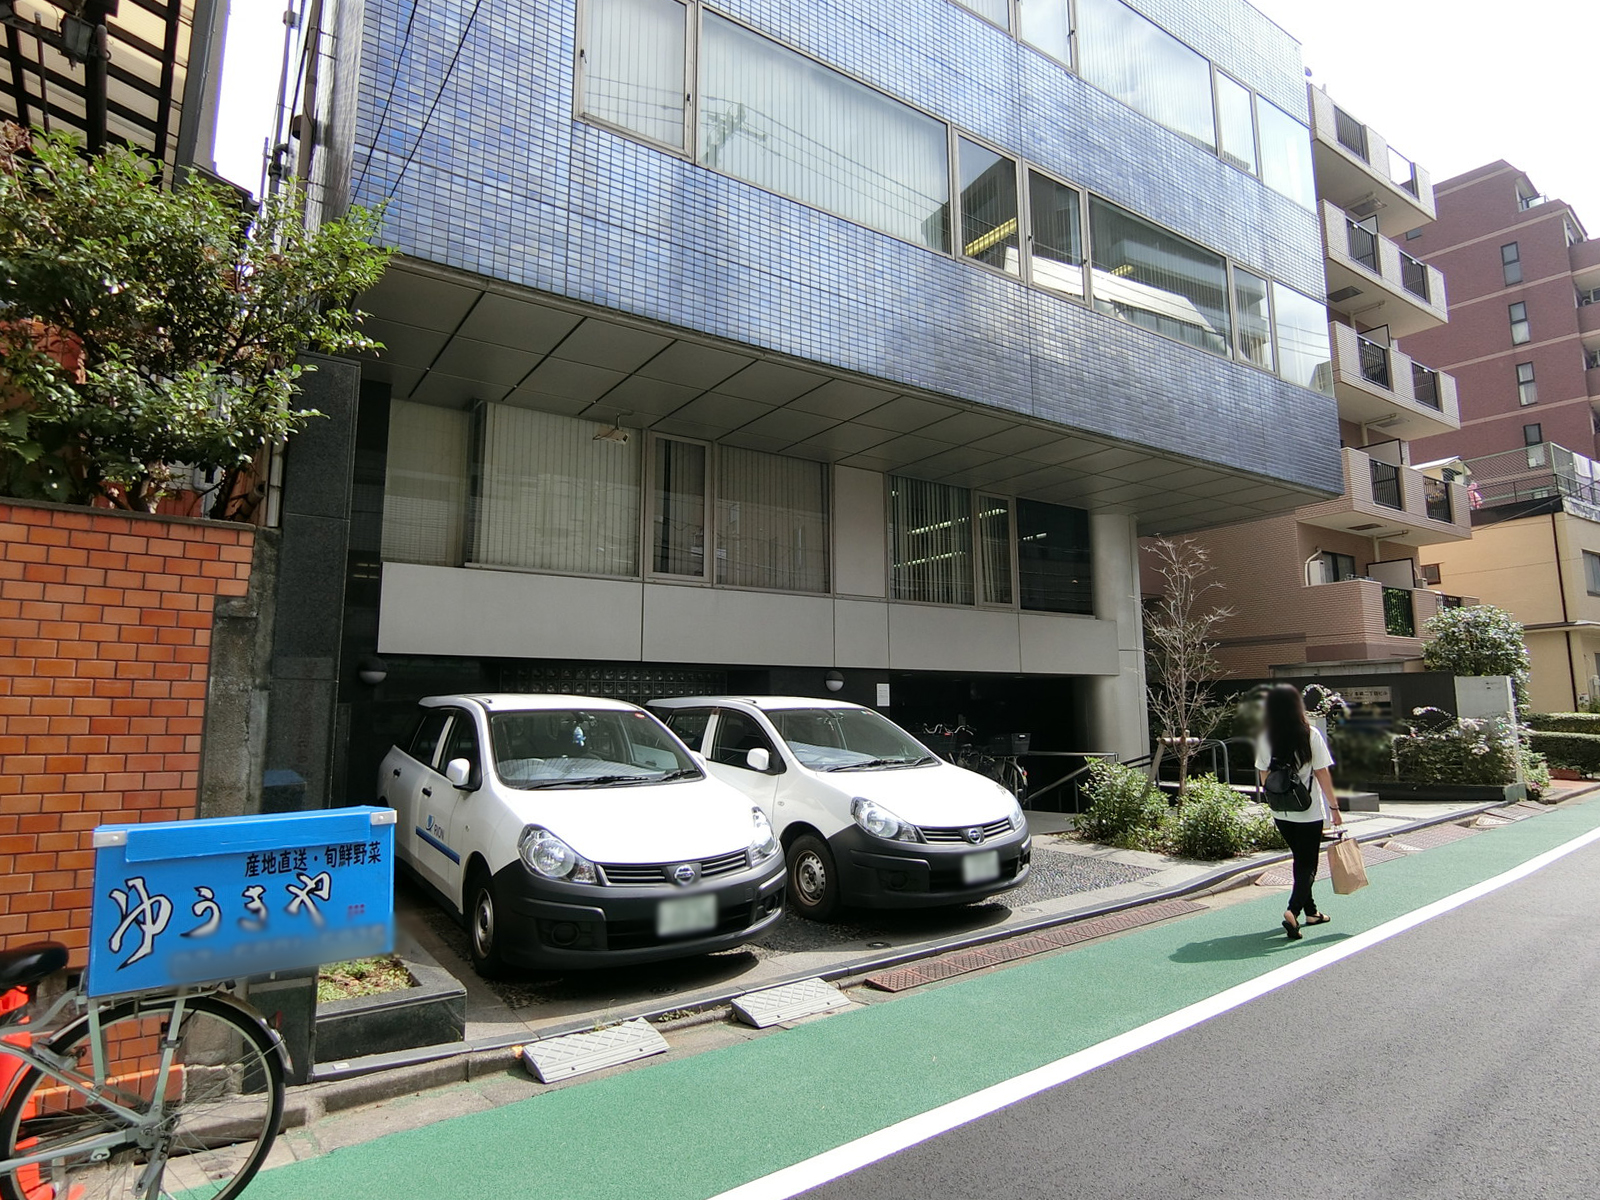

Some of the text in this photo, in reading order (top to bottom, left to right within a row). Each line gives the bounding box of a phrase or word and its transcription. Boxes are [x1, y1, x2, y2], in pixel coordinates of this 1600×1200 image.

[245, 841, 381, 878] 産地直送・旬鮮野菜
